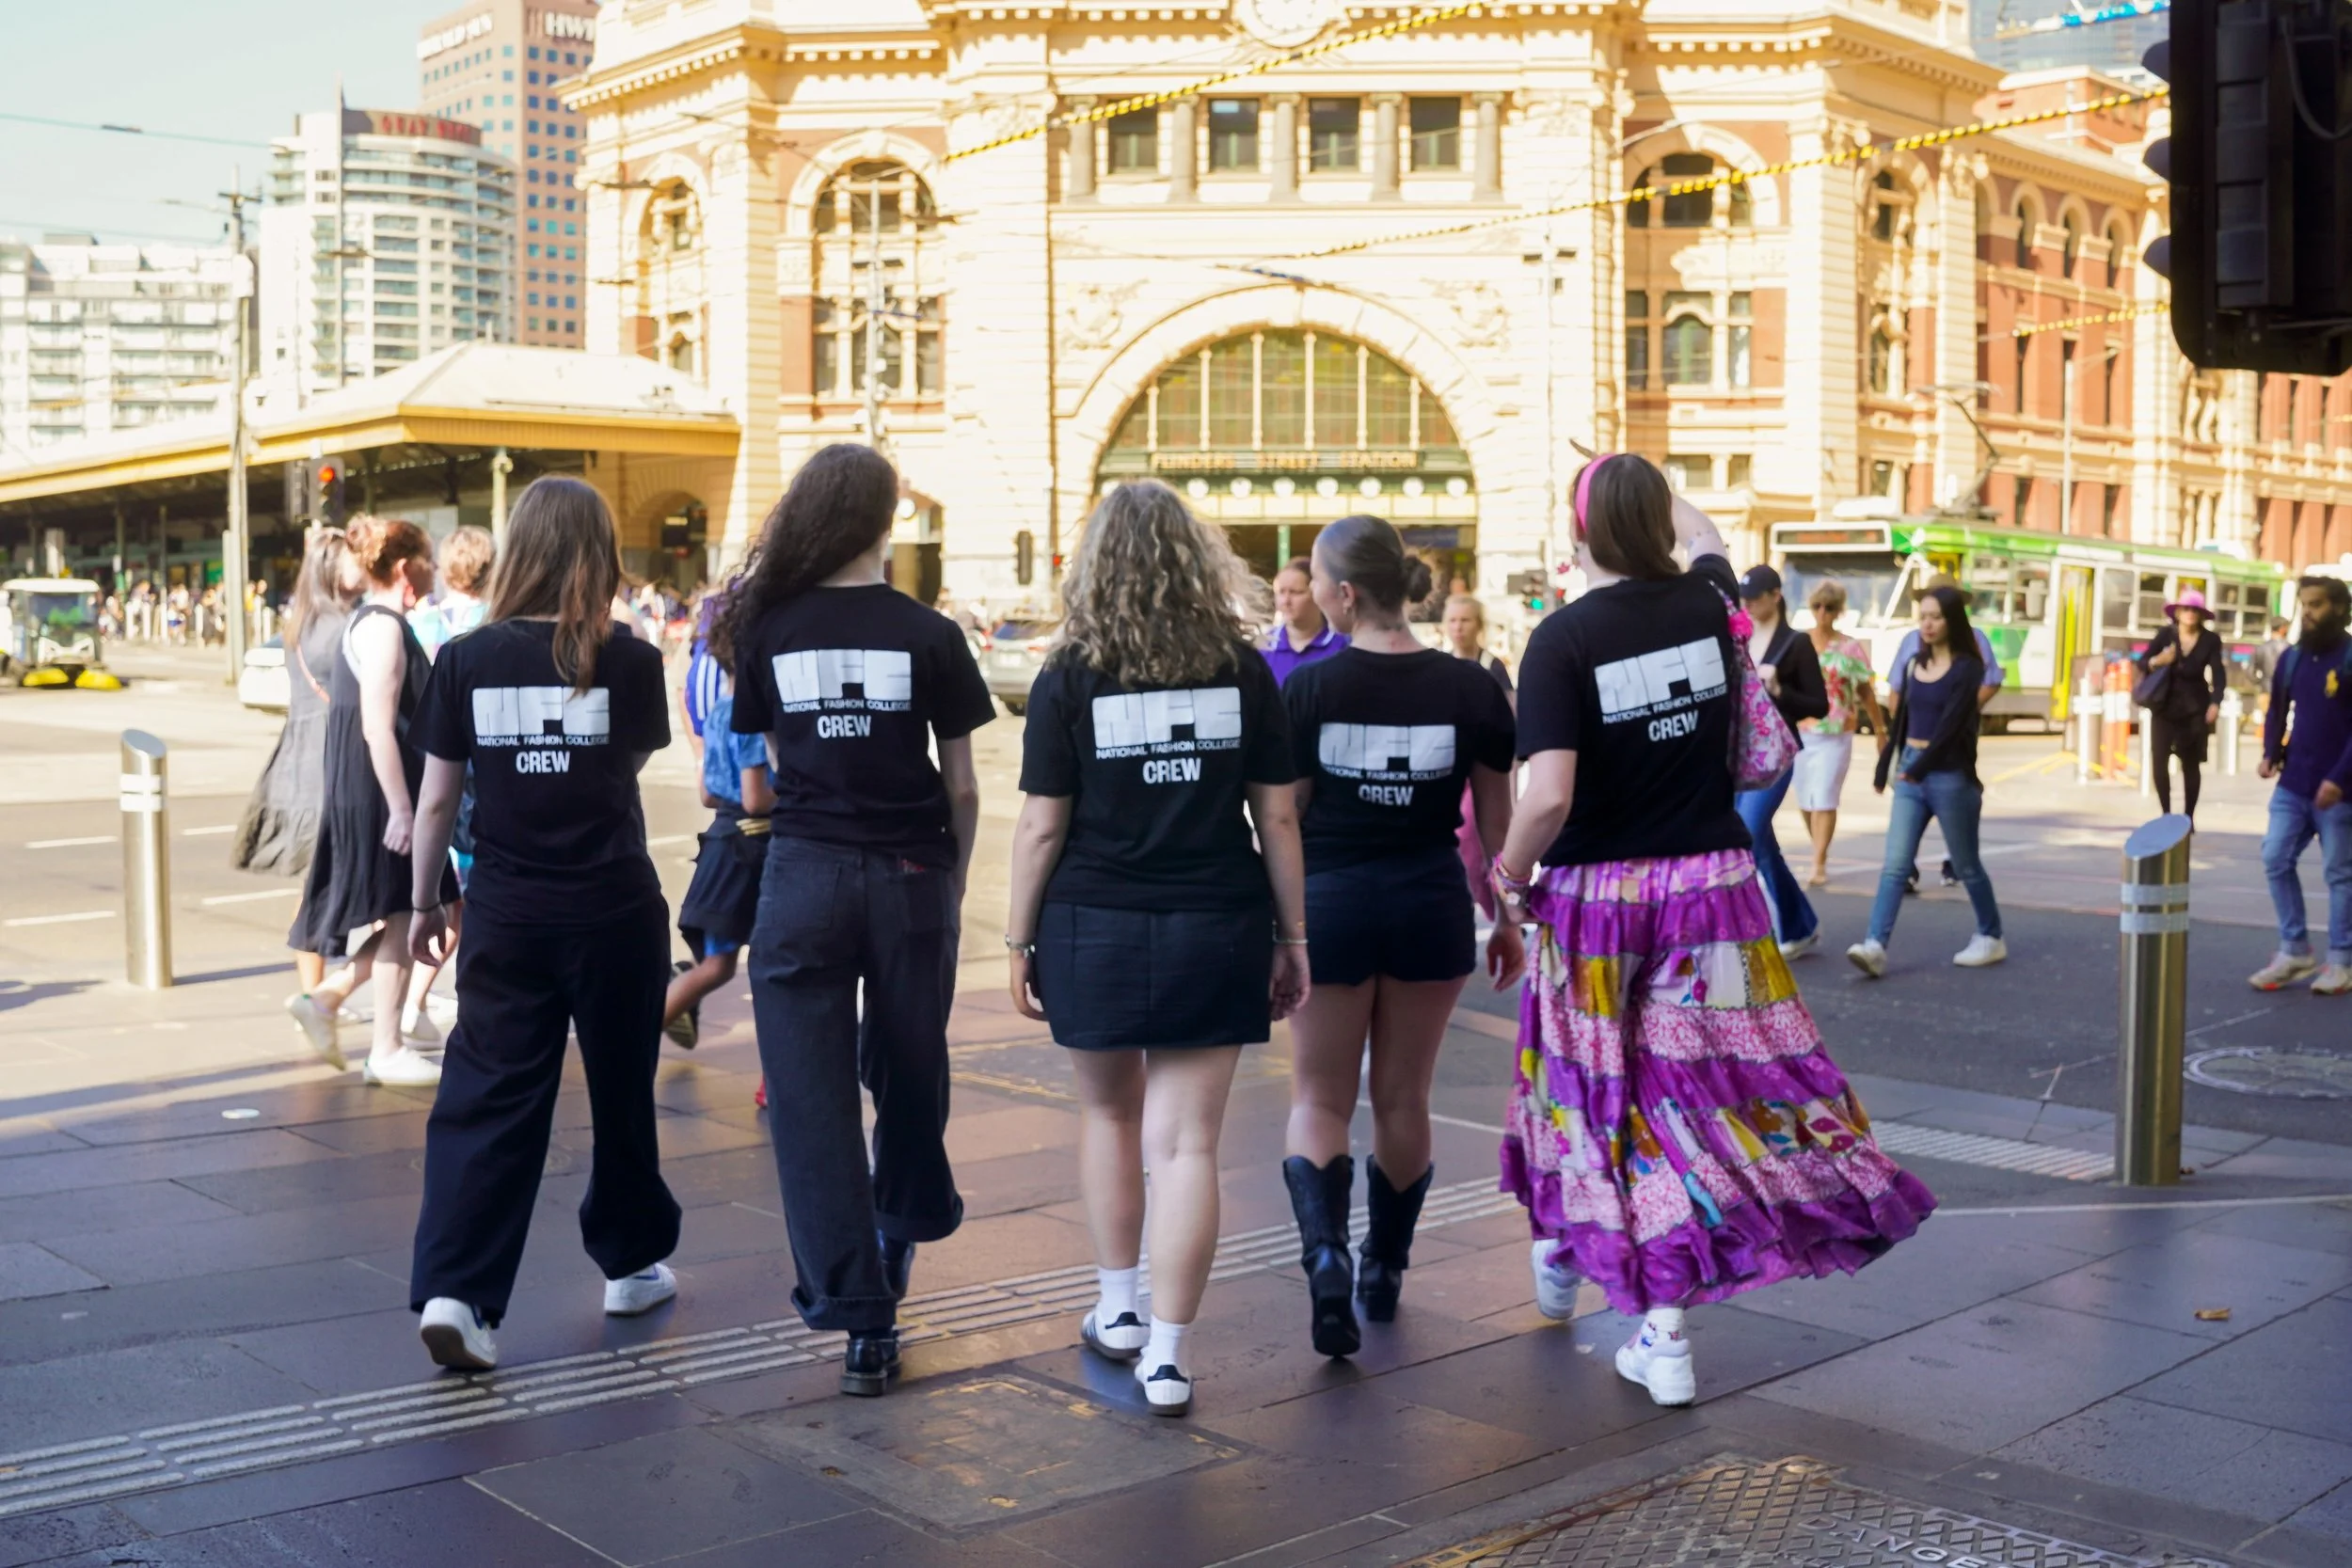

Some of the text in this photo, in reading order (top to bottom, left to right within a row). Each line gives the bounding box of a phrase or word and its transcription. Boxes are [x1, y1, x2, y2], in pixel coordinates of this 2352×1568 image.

[823, 699, 864, 709] FASHION
[866, 700, 912, 712] COLLEGE
[1602, 683, 1728, 724] NATIONAL FASHION COLLEGE
[817, 715, 871, 738] CREW
[1648, 709, 1699, 741] CREW
[477, 736, 519, 746] NATIONAL
[523, 736, 563, 746] FASHION
[1096, 738, 1241, 760] NATIONAL FASHION COLLEGE
[516, 751, 571, 773] CREW
[1143, 757, 1201, 784] CREW
[1366, 770, 1408, 781] FASHION
[1359, 784, 1414, 806] CREW
[1798, 1515, 2010, 1568] DANGE
